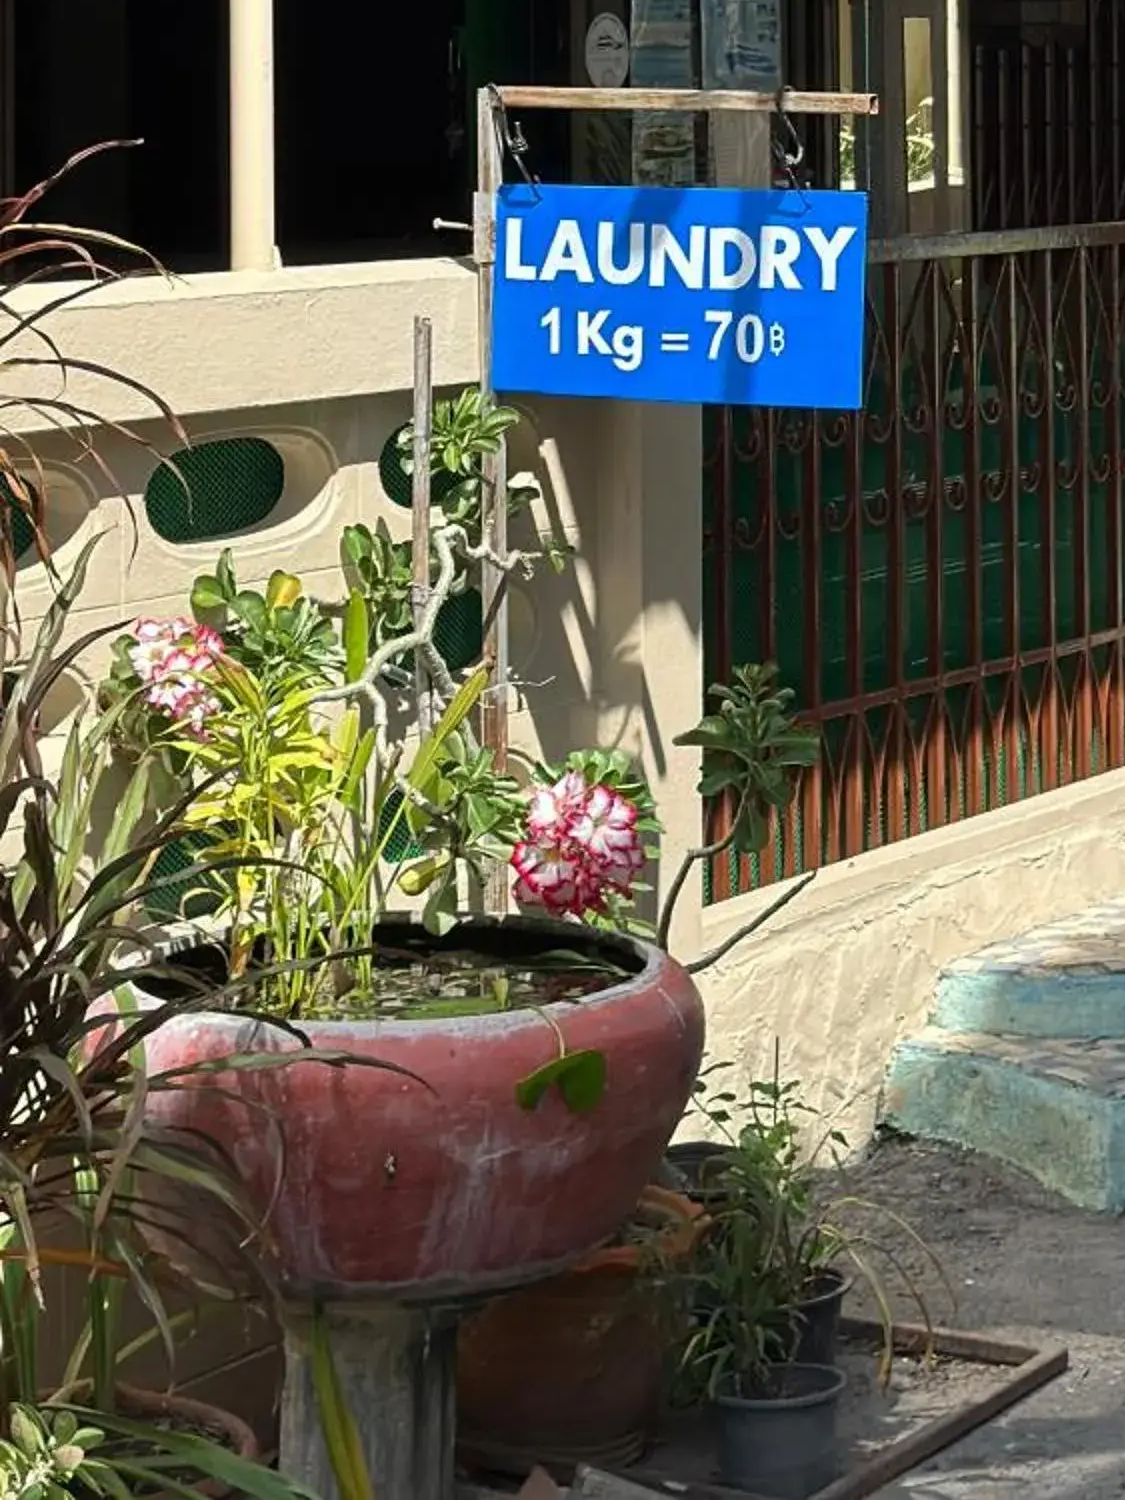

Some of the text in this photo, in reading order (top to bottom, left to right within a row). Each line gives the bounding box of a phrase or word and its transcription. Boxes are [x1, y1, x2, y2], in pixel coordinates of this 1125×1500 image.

[504, 217, 858, 291] LAUNDRY
[539, 307, 561, 355] 1
[576, 309, 644, 372] Kg
